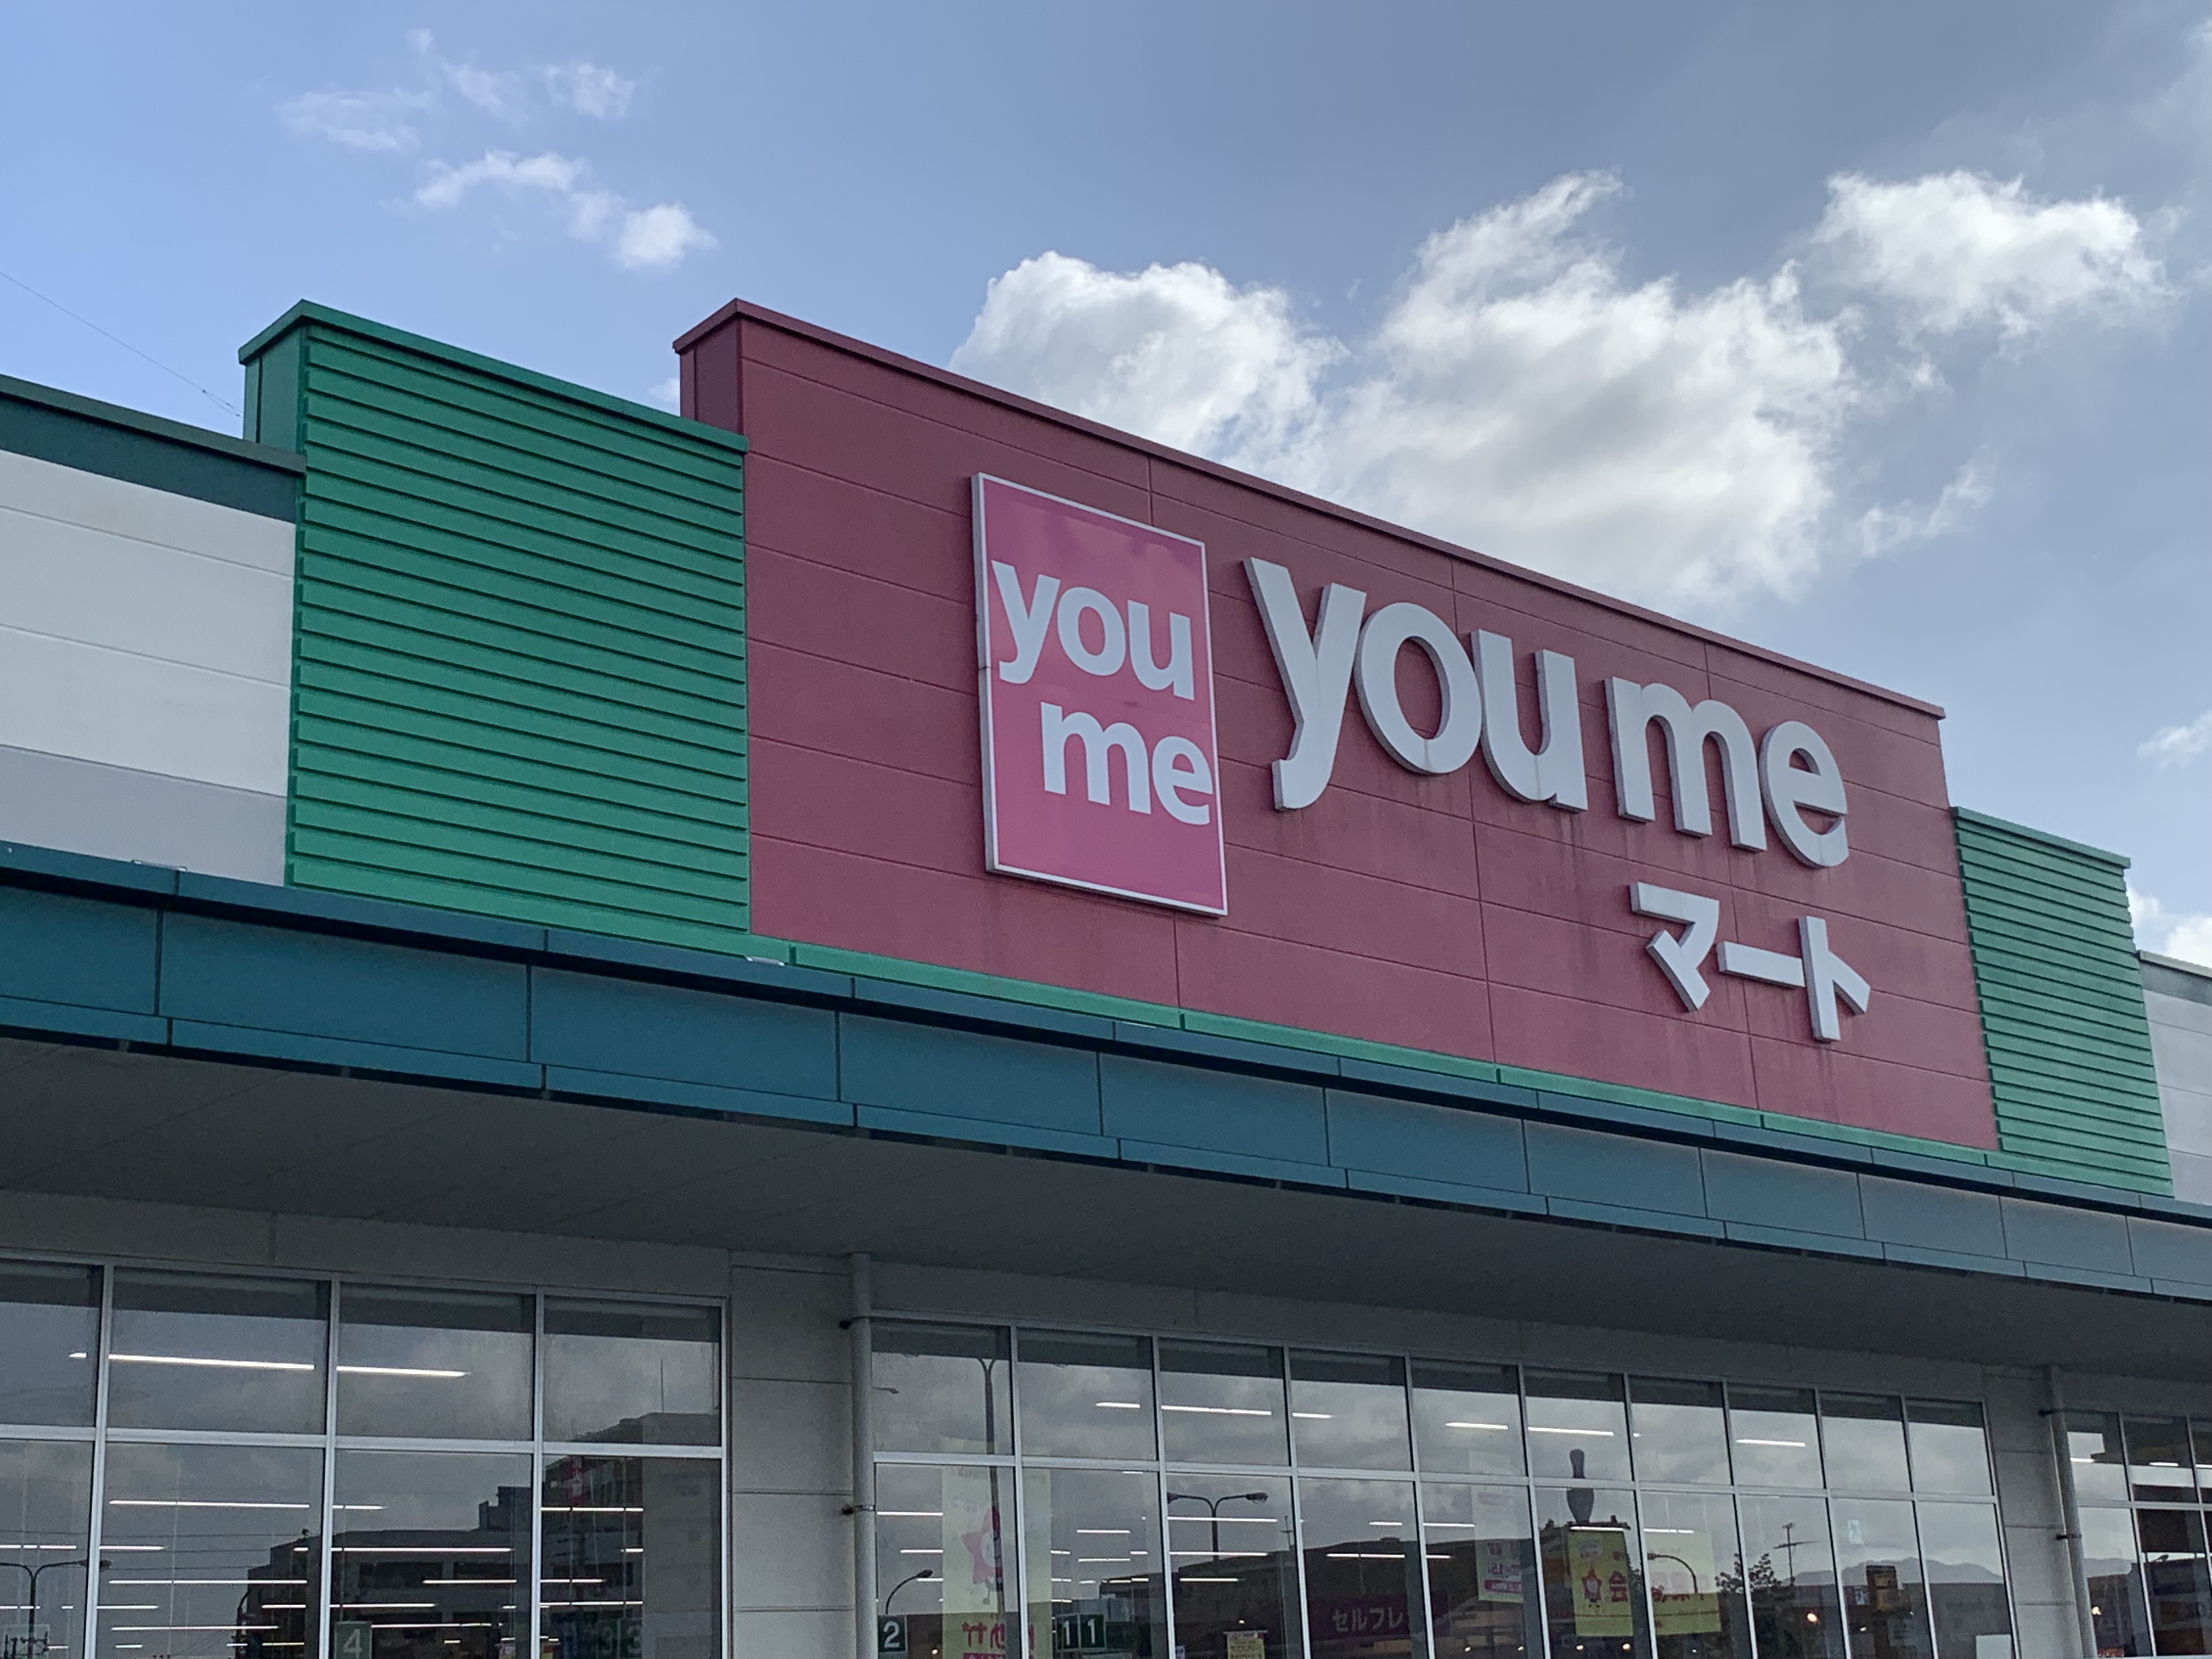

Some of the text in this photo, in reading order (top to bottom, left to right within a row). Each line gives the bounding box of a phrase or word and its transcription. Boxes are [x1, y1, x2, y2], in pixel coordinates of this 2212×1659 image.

[991, 560, 1195, 701] you
[1040, 701, 1215, 826] me
[1243, 556, 1850, 870] you me
[1629, 881, 1871, 1042] マート
[343, 1628, 363, 1658] 4
[883, 1620, 900, 1649] 2
[1331, 1606, 1421, 1633] セルフレ
